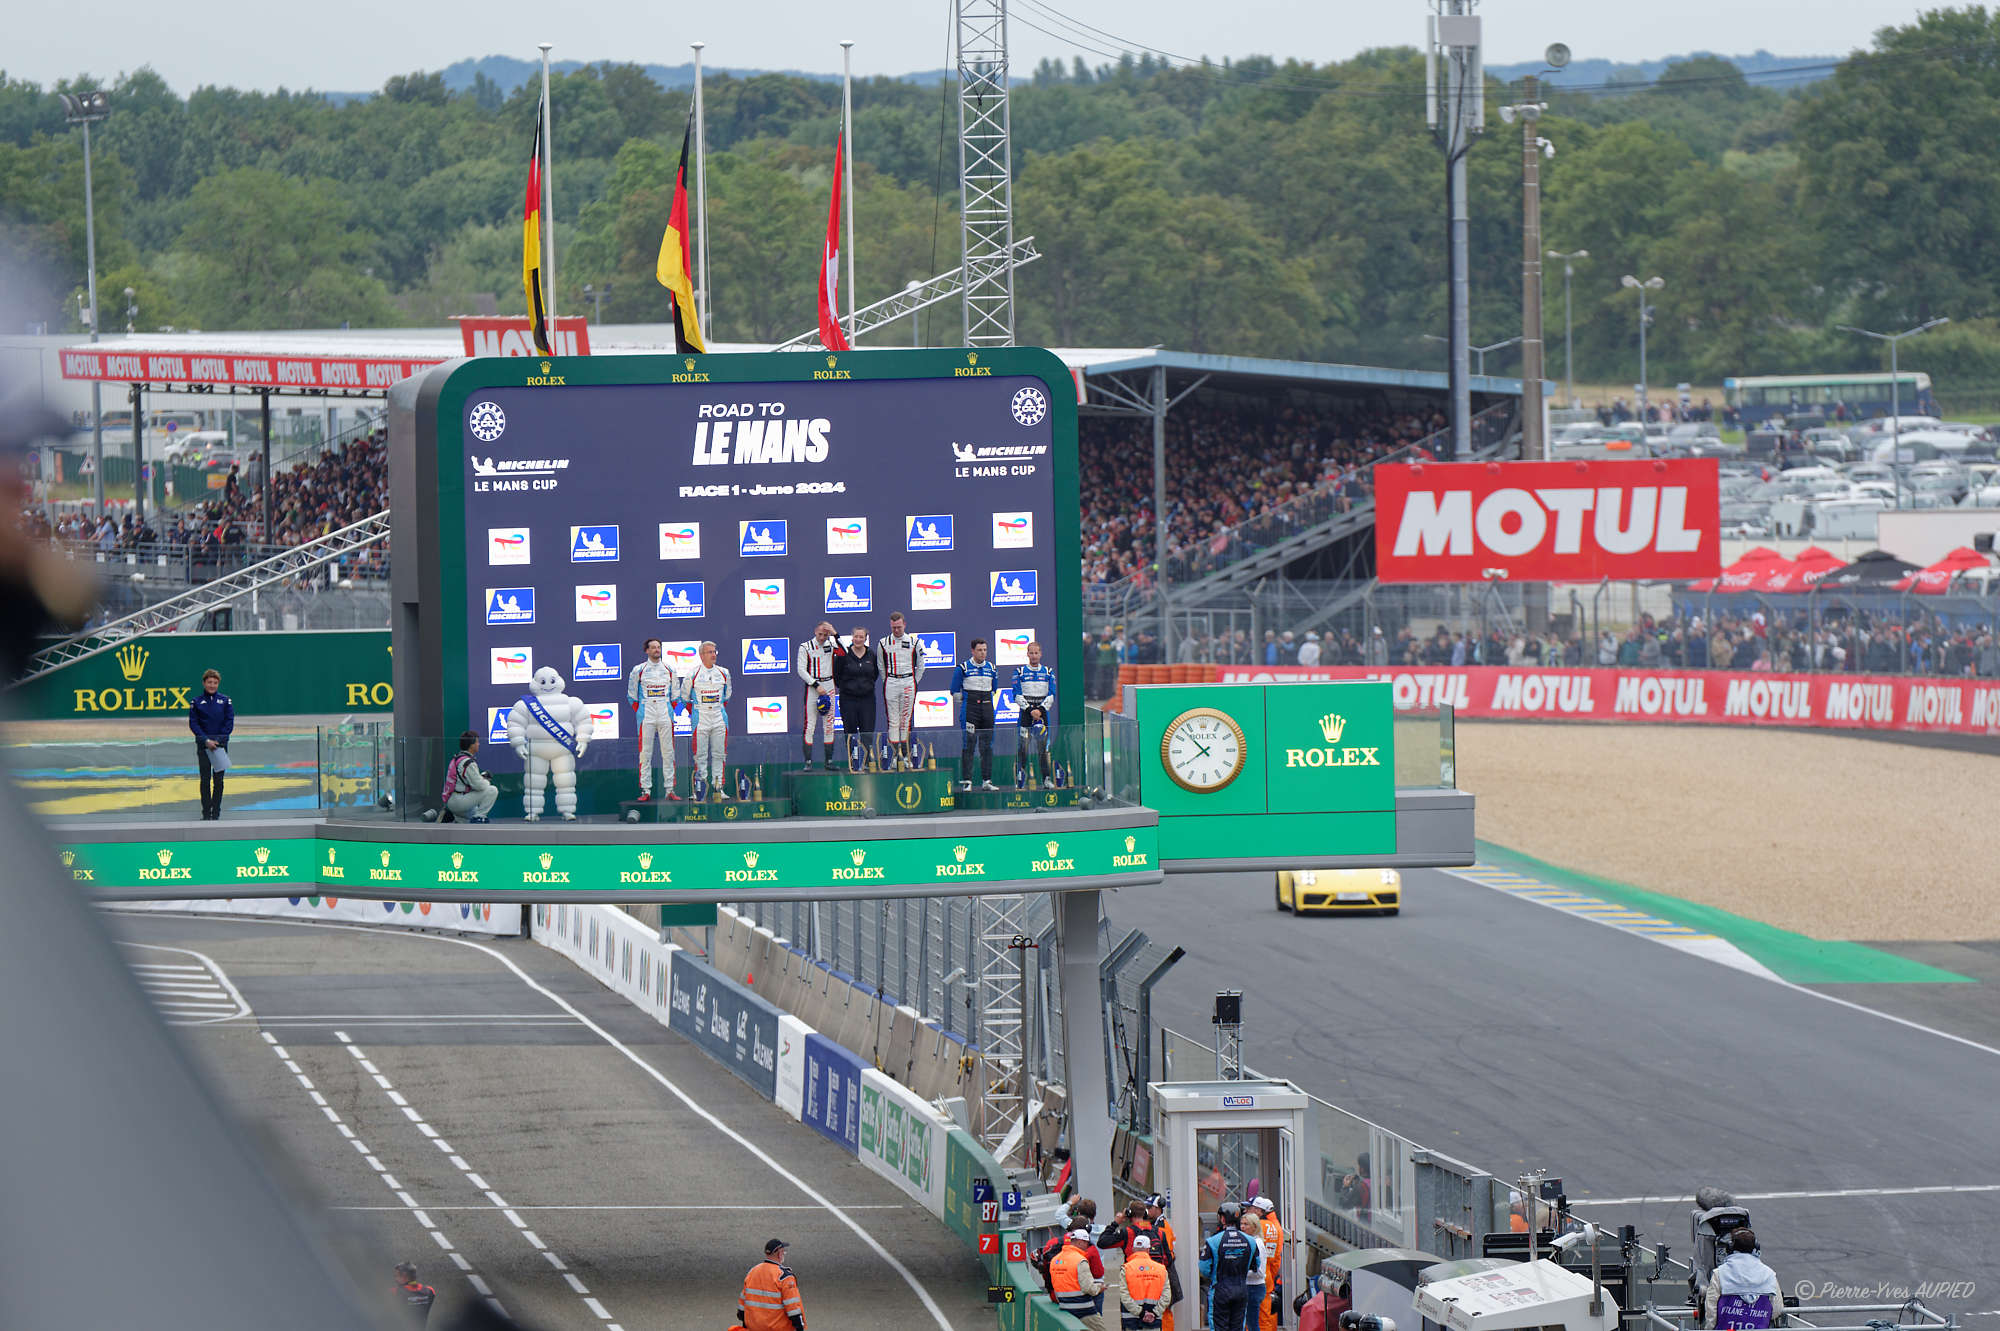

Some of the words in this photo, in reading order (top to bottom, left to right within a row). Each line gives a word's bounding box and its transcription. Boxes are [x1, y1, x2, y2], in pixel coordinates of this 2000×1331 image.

[67, 354, 101, 375] MOTUL
[107, 356, 143, 377] MOTUL
[149, 357, 186, 378] MOTUL
[191, 358, 228, 380] MOTUL
[234, 360, 272, 382] MOTUL
[278, 362, 316, 384] MOTUL
[322, 362, 360, 384] MOTUL
[814, 370, 851, 379] ROLEX
[955, 368, 991, 376] ROLEX
[527, 376, 565, 386] ROLEX
[672, 373, 710, 382] ROLEX
[698, 404, 754, 418] ROAD
[758, 402, 784, 416] TO
[692, 421, 732, 466] LE
[734, 418, 830, 464] MANS
[978, 445, 1047, 456] MICHELIN
[497, 459, 569, 471] MICHELIN
[955, 467, 969, 477] LE
[973, 466, 1007, 476] MANS
[1011, 465, 1036, 475] CUP
[474, 481, 490, 491] LE
[493, 480, 528, 491] MANS
[533, 480, 557, 490] CUP
[679, 485, 730, 498] RACE
[732, 484, 740, 496] 1
[749, 484, 794, 496] June
[796, 482, 846, 494] 2024
[1393, 486, 1701, 556] MOTUL
[742, 545, 784, 553] MICHELIN
[909, 540, 951, 548] MICHELIN
[573, 550, 616, 559] MICHELIN
[827, 600, 869, 609] MICHELIN
[993, 594, 1035, 603] MICHELIN
[489, 612, 532, 621] MICHELIN
[659, 606, 702, 615] MICHELIN
[1491, 675, 1594, 711] MOTUL
[1615, 677, 1708, 715] MOTUL
[1724, 680, 1811, 718] MOTUL
[74, 687, 191, 712] ROLEX
[1826, 683, 1893, 722] MOTUL
[1907, 686, 1962, 726] MOTUL
[530, 702, 570, 745] MICHELIN
[1286, 748, 1380, 767] ROLEX
[905, 787, 913, 803] 1
[728, 808, 734, 816] 2
[826, 801, 866, 811] ROLEX
[1032, 859, 1074, 872] ROLEX
[1113, 854, 1147, 867] ROLEX
[139, 868, 192, 880] ROLEX
[236, 866, 289, 878] ROLEX
[322, 866, 344, 878] ROLEX
[370, 868, 402, 880] ROLEX
[725, 870, 778, 882] ROLEX
[832, 867, 884, 880] ROLEX
[936, 864, 985, 876] ROLEX
[438, 871, 478, 882] ROLEX
[523, 872, 570, 883] ROLEX
[620, 872, 672, 883] ROLEX
[976, 1189, 984, 1200] 7
[1007, 1193, 1015, 1205] 8
[982, 1202, 998, 1221] 87
[982, 1238, 991, 1250] 7
[1012, 1244, 1020, 1257] 8
[1005, 1292, 1012, 1302] 9
